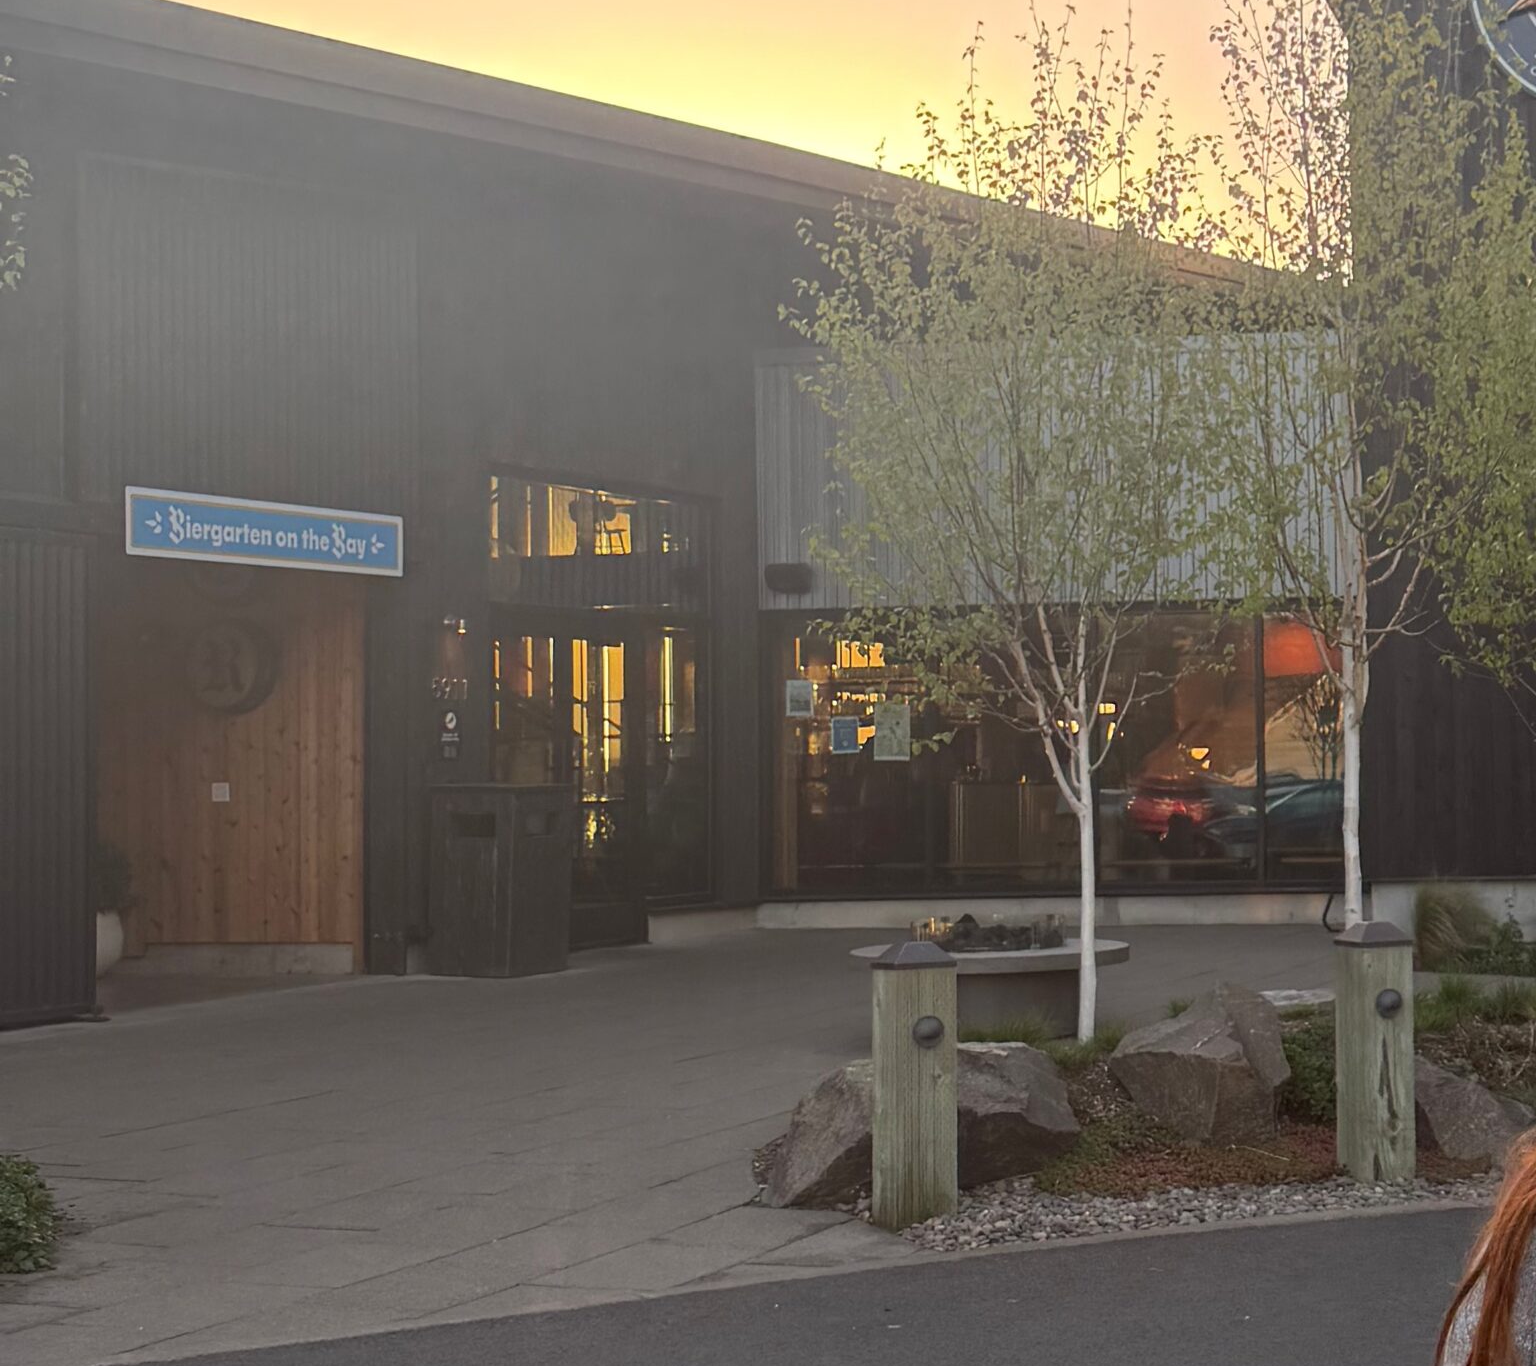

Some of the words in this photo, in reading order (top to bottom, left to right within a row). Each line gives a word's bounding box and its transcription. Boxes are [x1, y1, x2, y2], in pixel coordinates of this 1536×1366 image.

[168, 505, 272, 547] Biergarten
[276, 529, 298, 549] on
[302, 529, 330, 552] the
[331, 523, 367, 559] Bay
